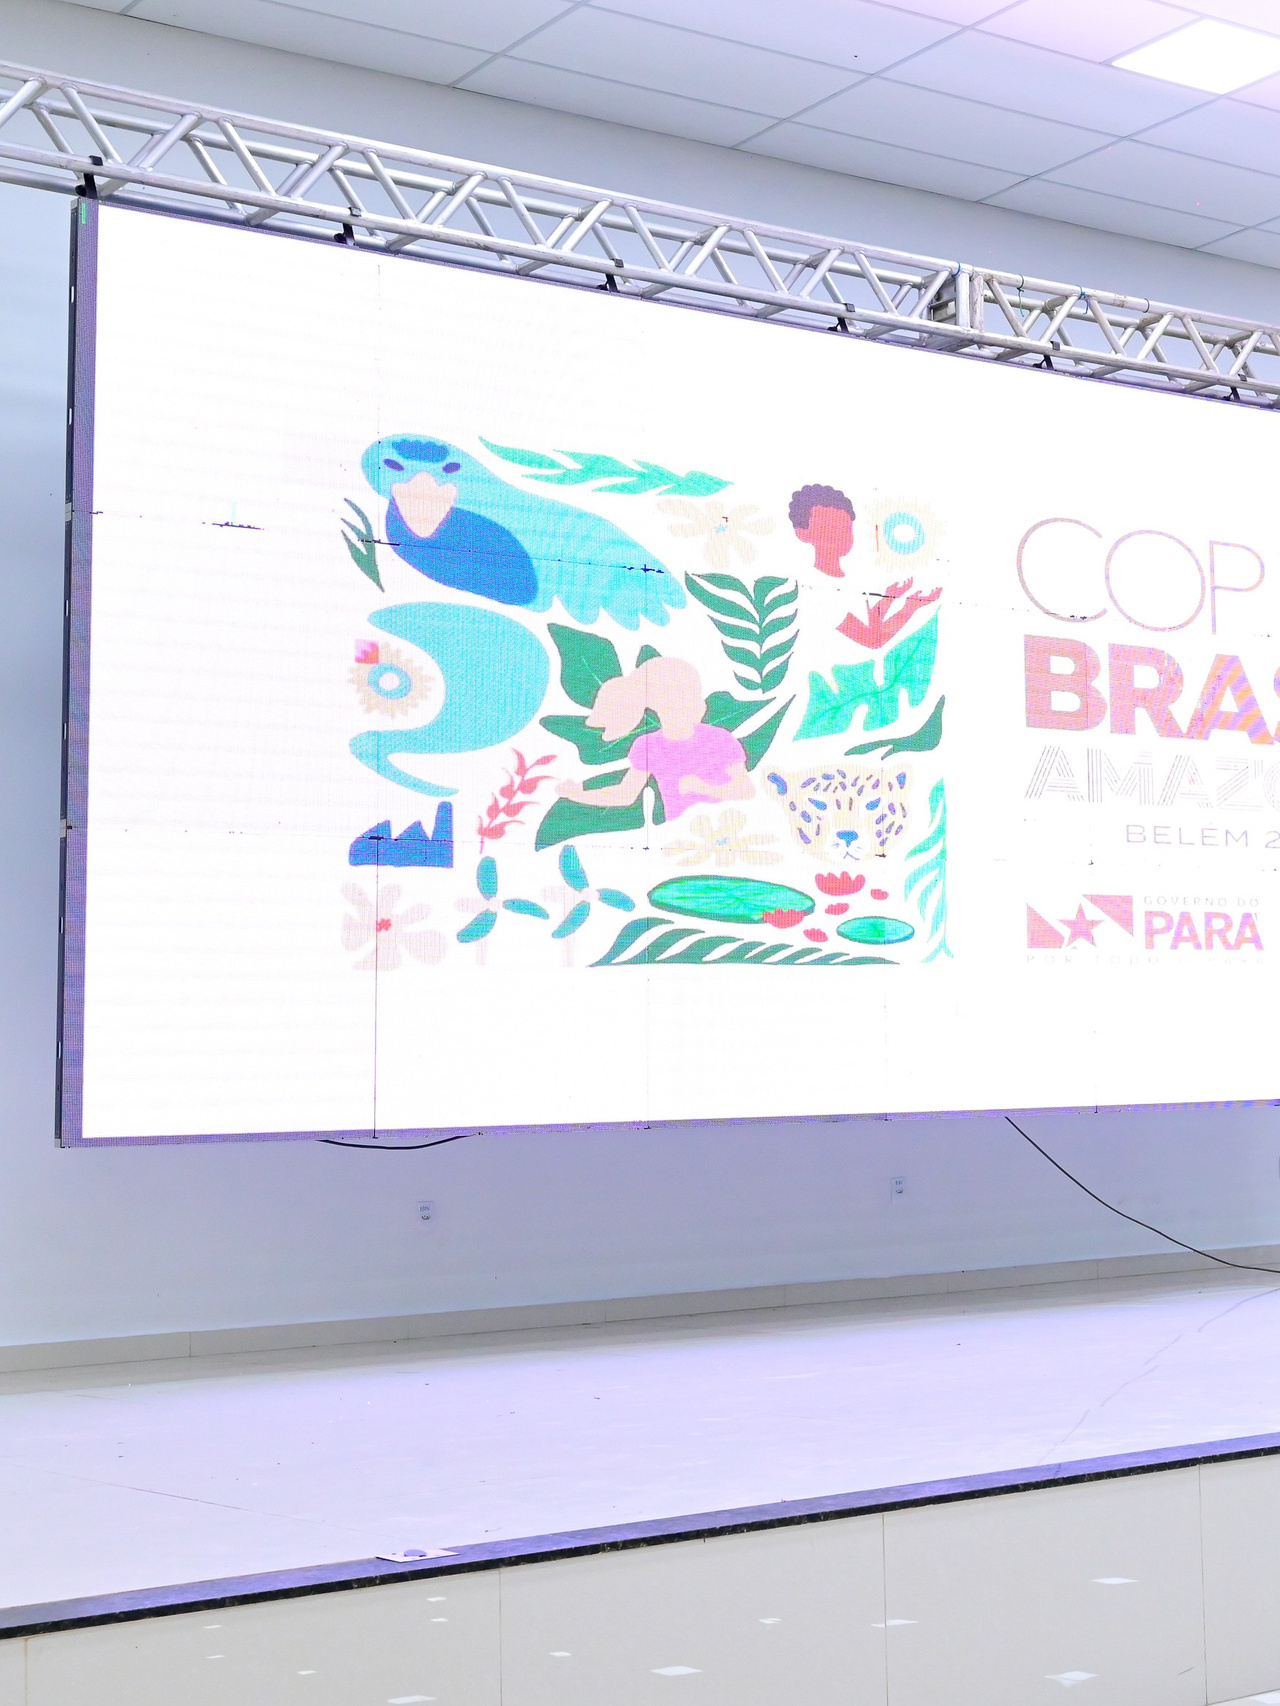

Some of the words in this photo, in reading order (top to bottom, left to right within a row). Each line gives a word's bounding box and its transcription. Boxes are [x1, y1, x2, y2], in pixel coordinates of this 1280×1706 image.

[1125, 823, 1249, 848] BELÉM
[1144, 895, 1227, 907] GOVERNO
[1237, 897, 1260, 908] DO
